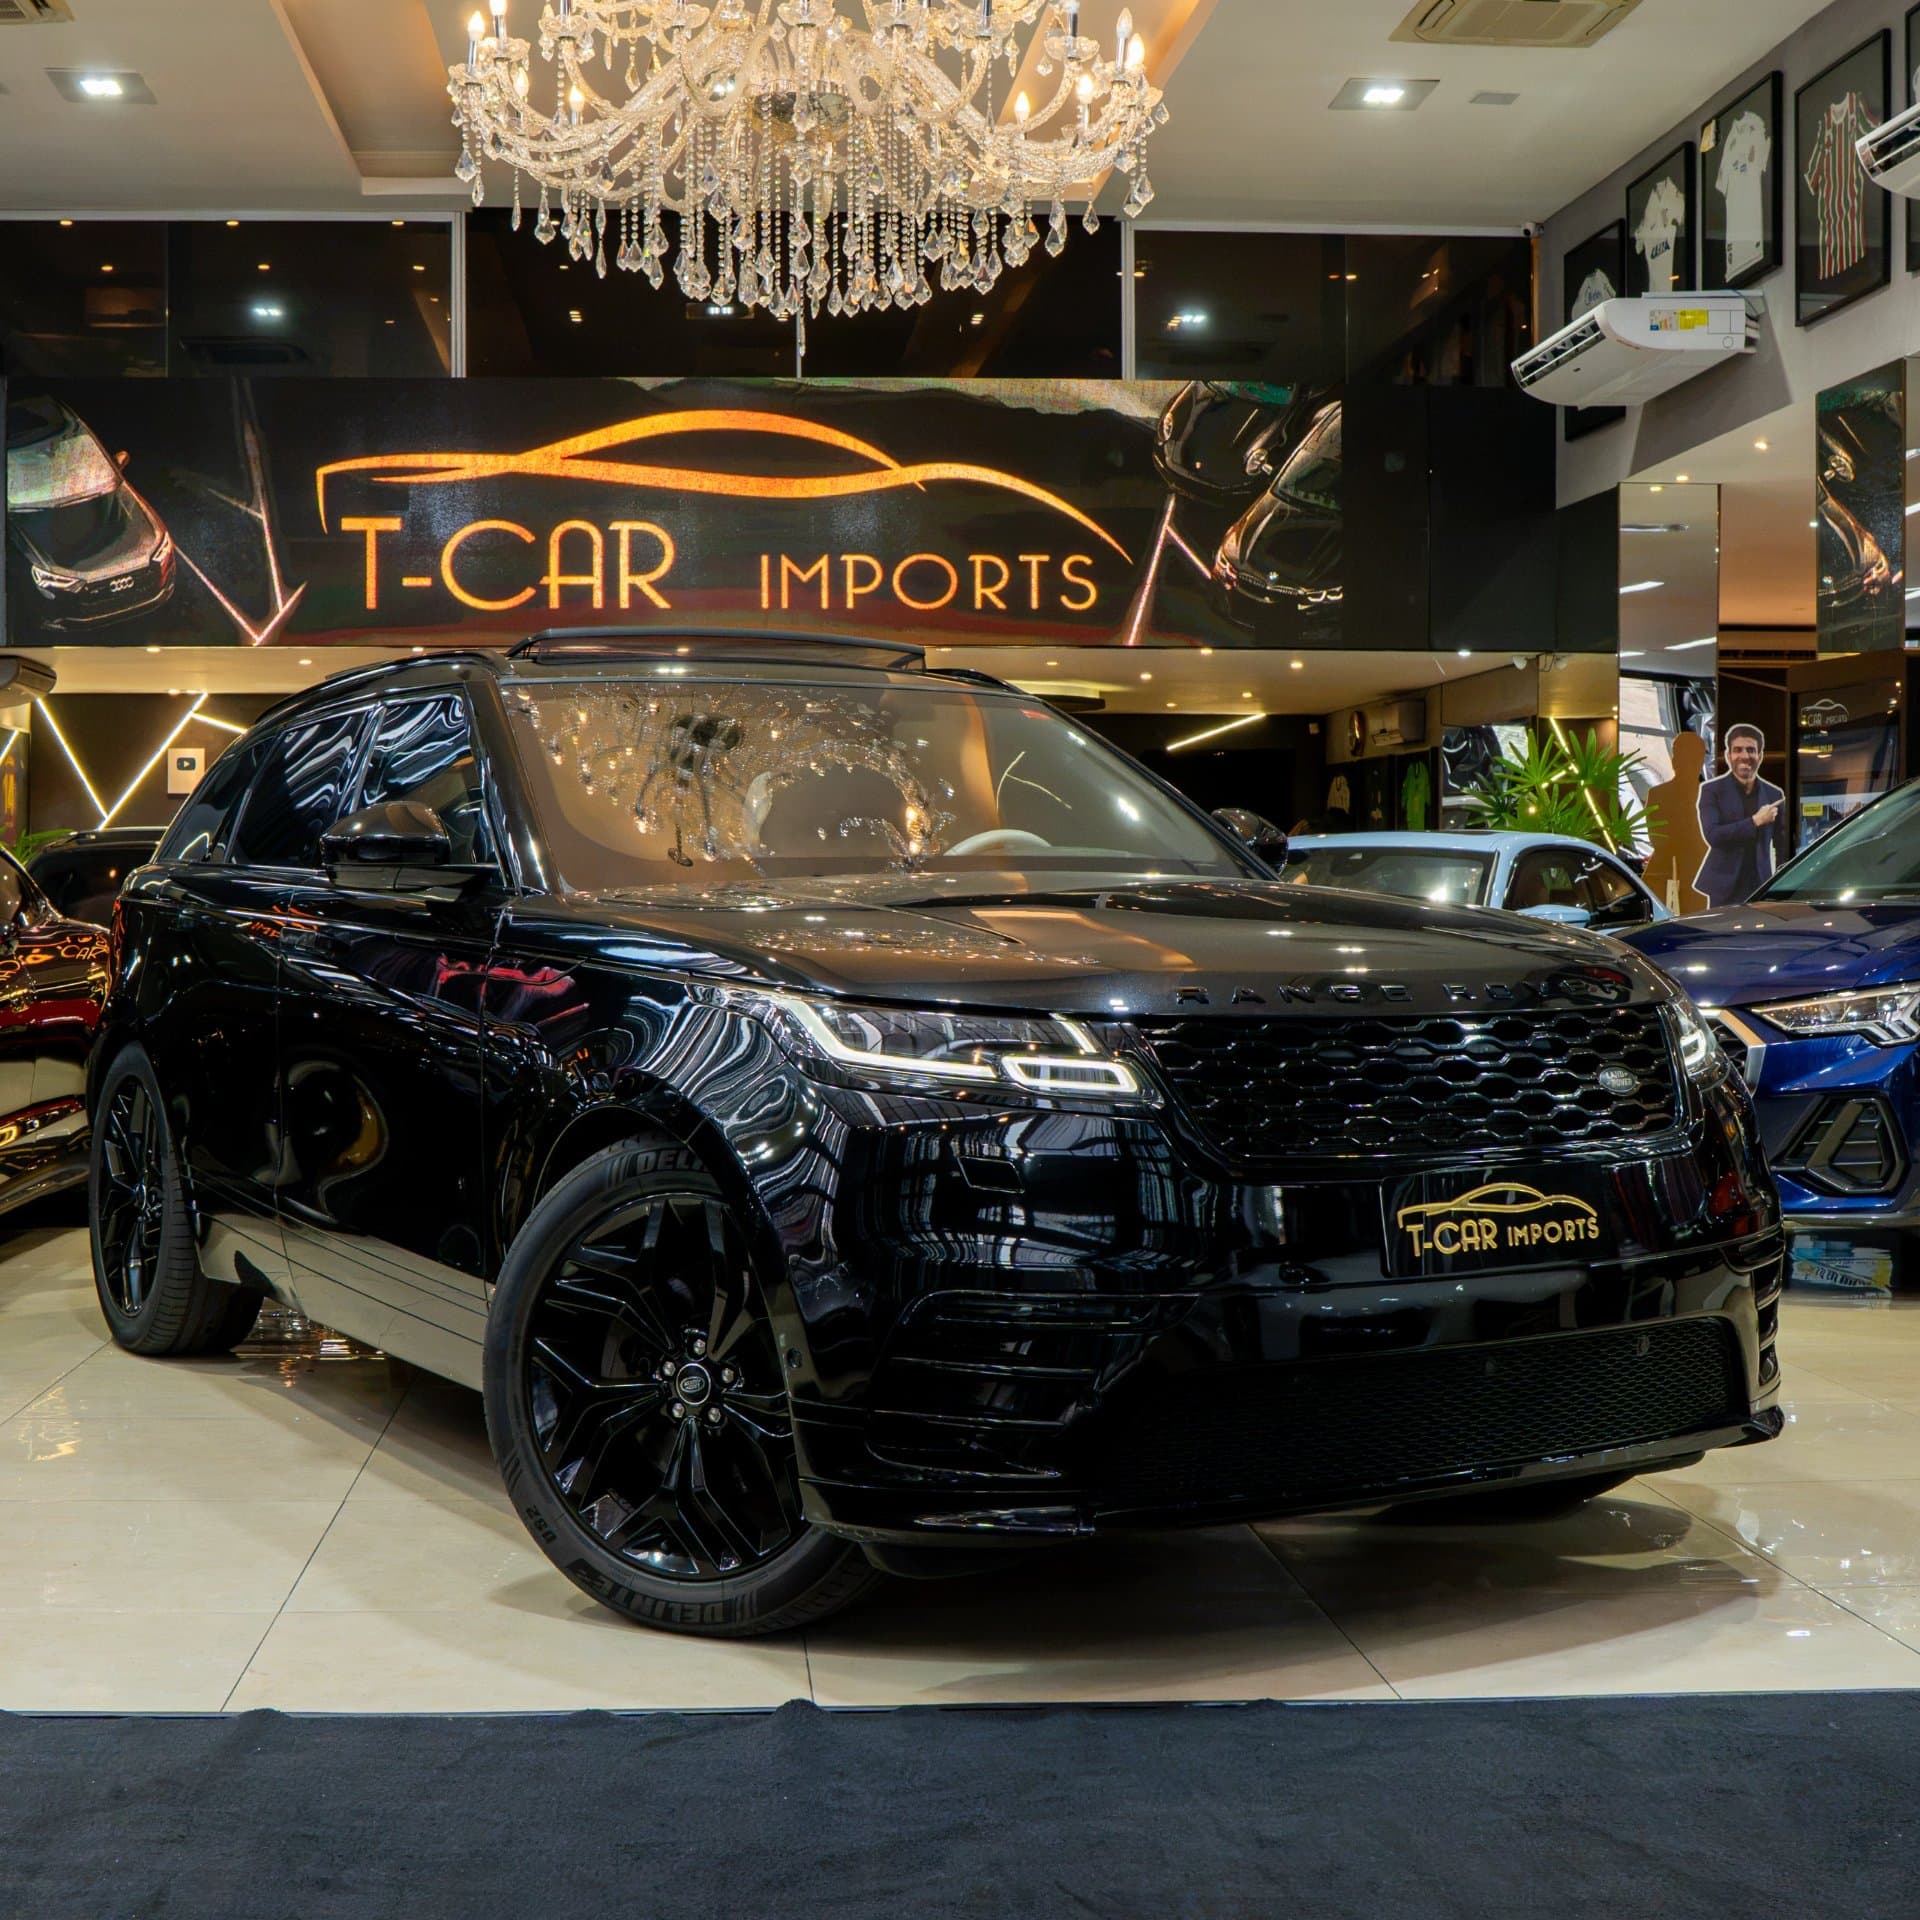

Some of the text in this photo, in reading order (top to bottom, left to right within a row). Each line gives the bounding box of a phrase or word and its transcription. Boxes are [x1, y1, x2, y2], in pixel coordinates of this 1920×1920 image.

[341, 517, 1100, 613] T-CAR IMPORTS
[1175, 984, 1414, 1004] RANGE
[1405, 1216, 1600, 1257] T-CAR IMPORTS
